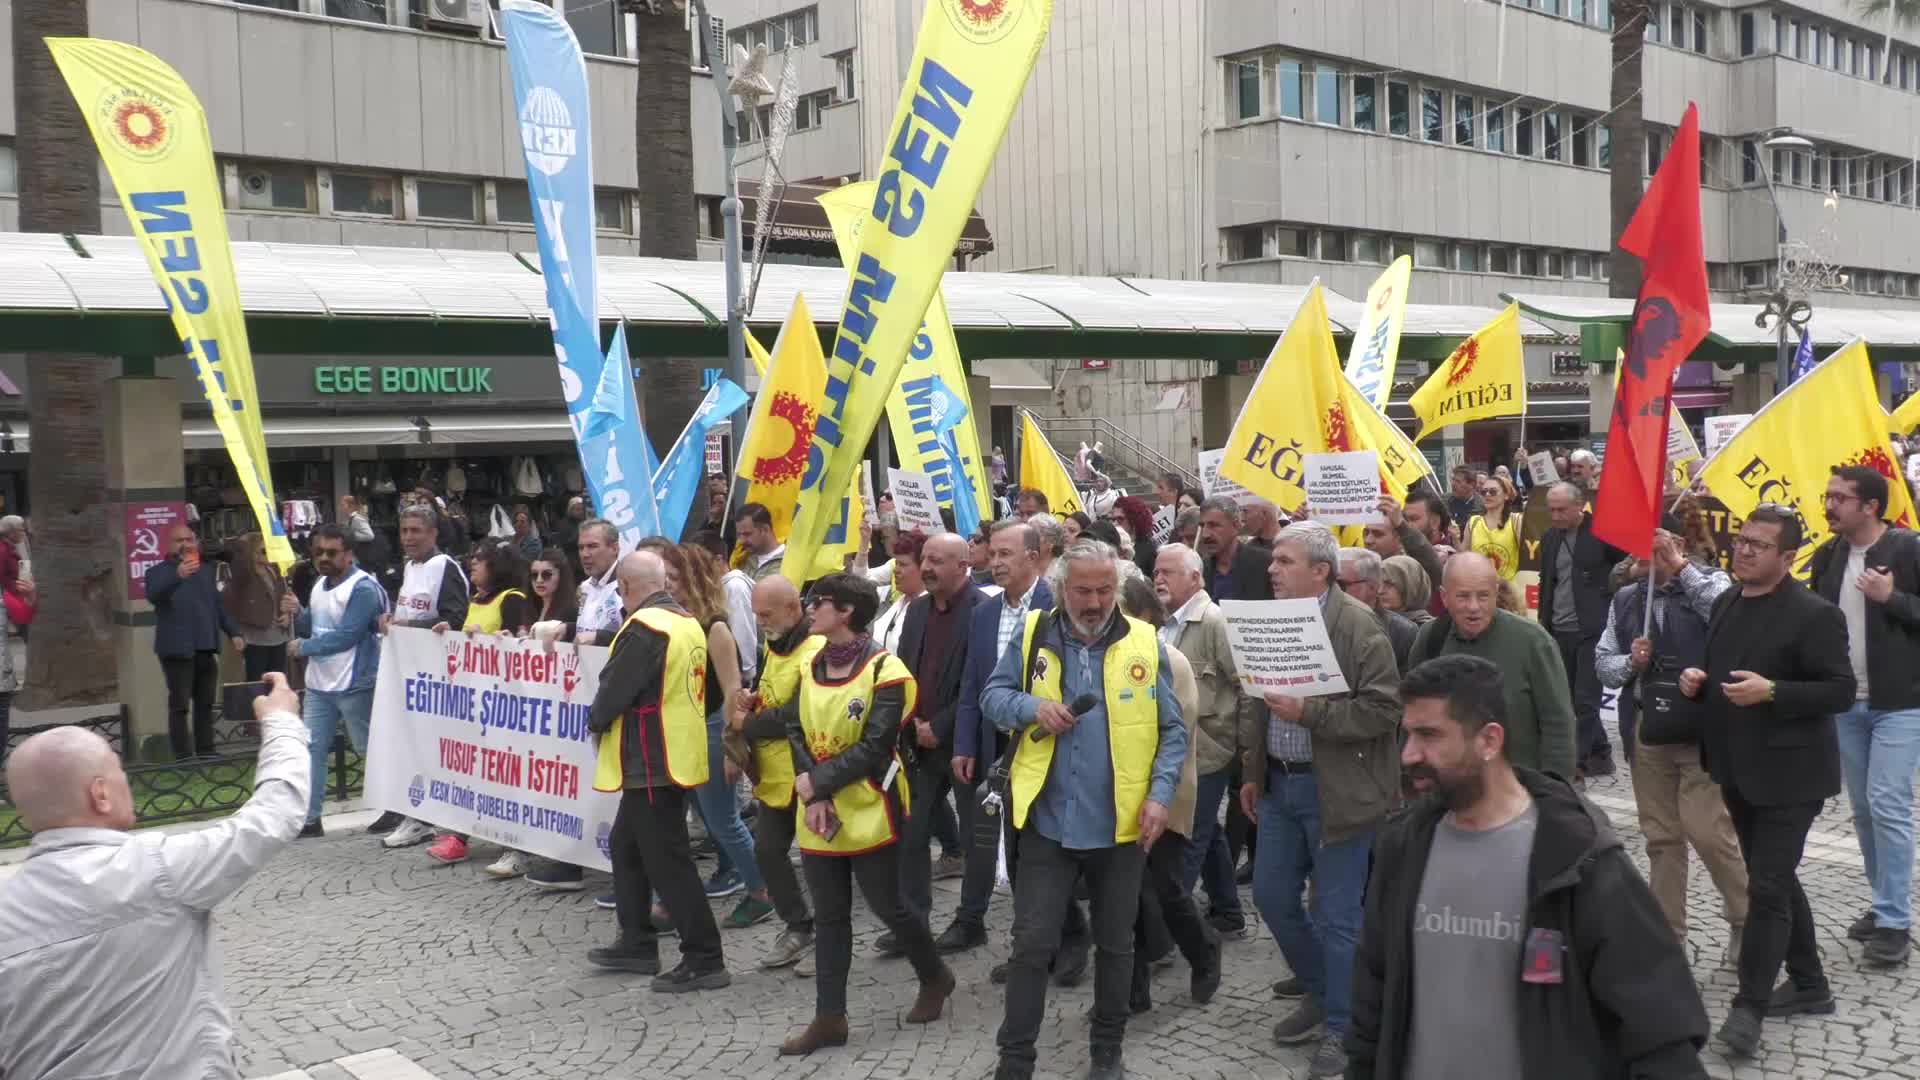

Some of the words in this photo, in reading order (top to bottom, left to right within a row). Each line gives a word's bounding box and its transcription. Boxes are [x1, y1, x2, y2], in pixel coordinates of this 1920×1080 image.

[315, 366, 373, 393] EGE
[381, 366, 493, 393] BONCUK
[463, 641, 500, 677] Artık
[504, 647, 559, 685] yeter!
[405, 671, 475, 723] EĞİTİMDE
[480, 685, 552, 737] ŞİDDETE
[439, 737, 477, 777] YUSUF
[479, 743, 521, 788] TEKİN
[528, 750, 579, 800] İSTİFA
[429, 778, 450, 804] KESK
[450, 783, 475, 811] İZMİR
[476, 793, 519, 824] ŞUBELER
[522, 803, 584, 841] PLATFORMU
